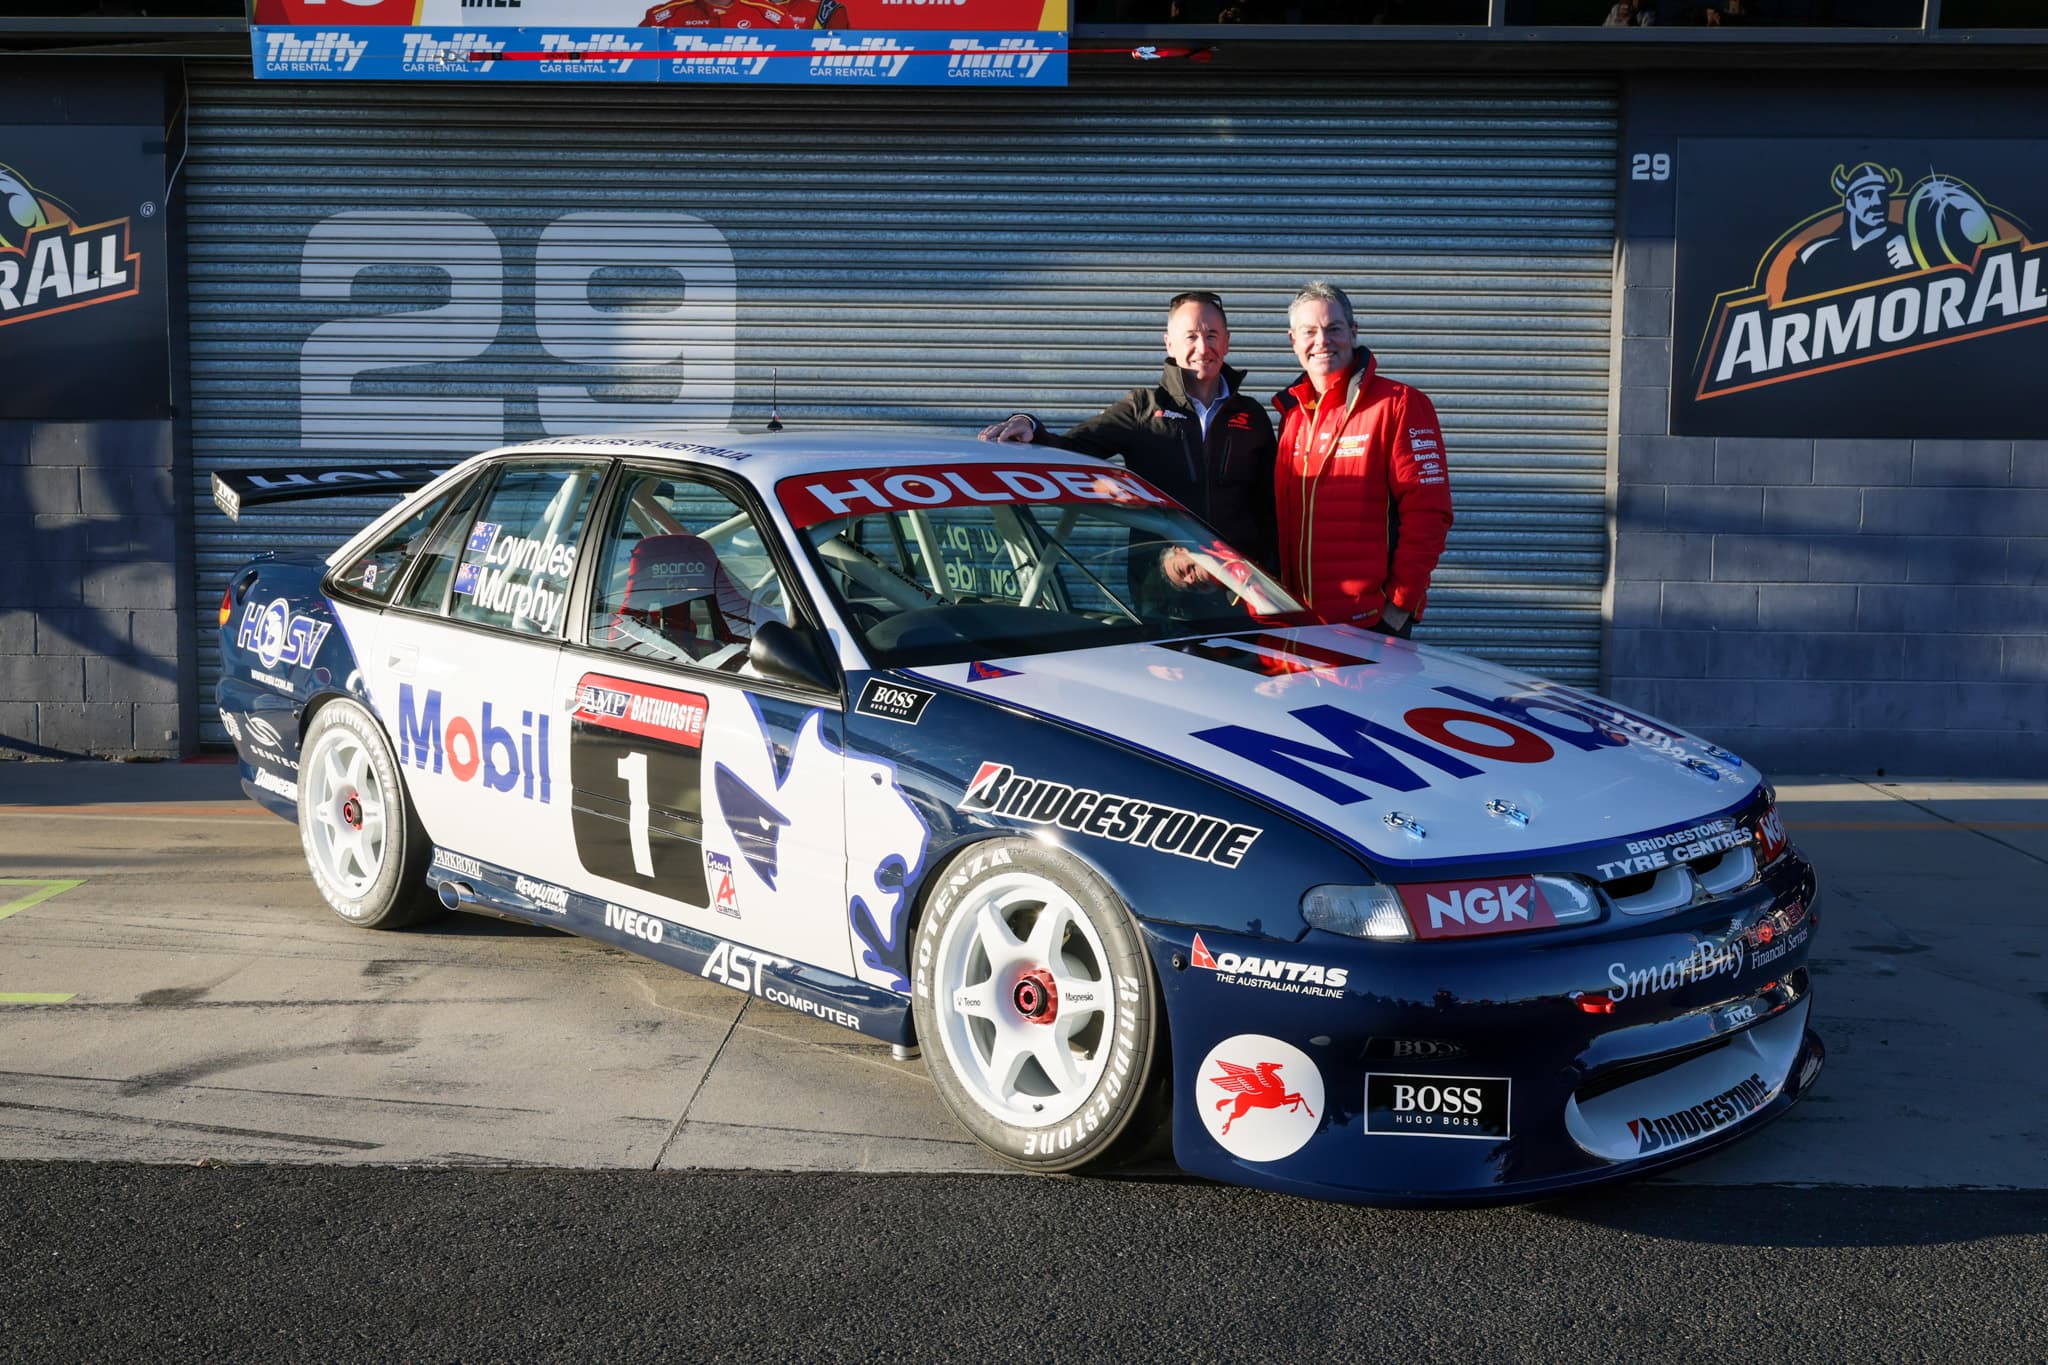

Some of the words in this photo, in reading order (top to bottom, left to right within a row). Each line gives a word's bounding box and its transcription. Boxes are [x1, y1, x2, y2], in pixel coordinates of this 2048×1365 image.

[266, 32, 368, 72] Thrifty
[267, 63, 288, 71] CAR
[292, 63, 332, 71] RENTAL
[403, 33, 506, 72] Thrifty
[403, 64, 425, 72] CAR
[428, 64, 468, 72] RENTAL
[540, 34, 644, 73] Thrifty
[540, 64, 562, 73] CAR
[565, 64, 605, 73] RENTAL
[672, 35, 776, 75] Thrifty
[672, 66, 694, 74] CAR
[698, 66, 738, 75] RENTAL
[810, 37, 914, 77] Thrifty
[948, 38, 1053, 78] Thrifty
[810, 68, 831, 76] CAR
[835, 67, 876, 77] RENTAL
[948, 69, 970, 78] CAR
[973, 69, 1014, 78] RENTAL
[1632, 153, 1671, 181] 29
[300, 211, 737, 449] 29
[805, 470, 1169, 515] HOLDEN
[485, 525, 578, 578] Lowndes
[652, 561, 705, 575] sparco
[472, 566, 564, 632] Murphy
[584, 689, 626, 717] AMP
[630, 694, 694, 733] BATHURST
[872, 686, 918, 709] BOSS
[399, 682, 551, 805] Mobil
[617, 751, 655, 878] 1
[958, 760, 1263, 869] BRIDGESTONE
[1597, 851, 1669, 879] TYRE
[1673, 826, 1753, 861] CENTRES
[1626, 819, 1725, 855] BRIDGESTONE
[433, 846, 483, 879] PARKROYAL
[515, 875, 569, 908] REVOLUTION
[716, 874, 735, 905] A
[1426, 883, 1528, 929] NGK
[605, 903, 664, 944] IVECO
[917, 847, 1013, 999] POTENZA
[701, 941, 772, 998] AST
[1217, 952, 1349, 987] QANTAS
[1608, 940, 1745, 1002] SmartBuy
[1752, 938, 1786, 970] Financial
[963, 996, 981, 1007] Tecno
[1065, 991, 1094, 1004] Magnesio
[1216, 972, 1236, 984] THE
[1238, 976, 1300, 994] AUSTRALIAN
[1301, 986, 1345, 999] AIRLINE
[765, 986, 861, 1031] COMPUTER
[1723, 1004, 1757, 1026] TWR
[1023, 972, 1140, 1156] BRIDGESTONE
[1392, 1083, 1483, 1115] BOSS
[1627, 1072, 1772, 1154] BRIDGESTONE
[1396, 1114, 1433, 1125] HUGO
[1443, 1116, 1479, 1127] BOSS
